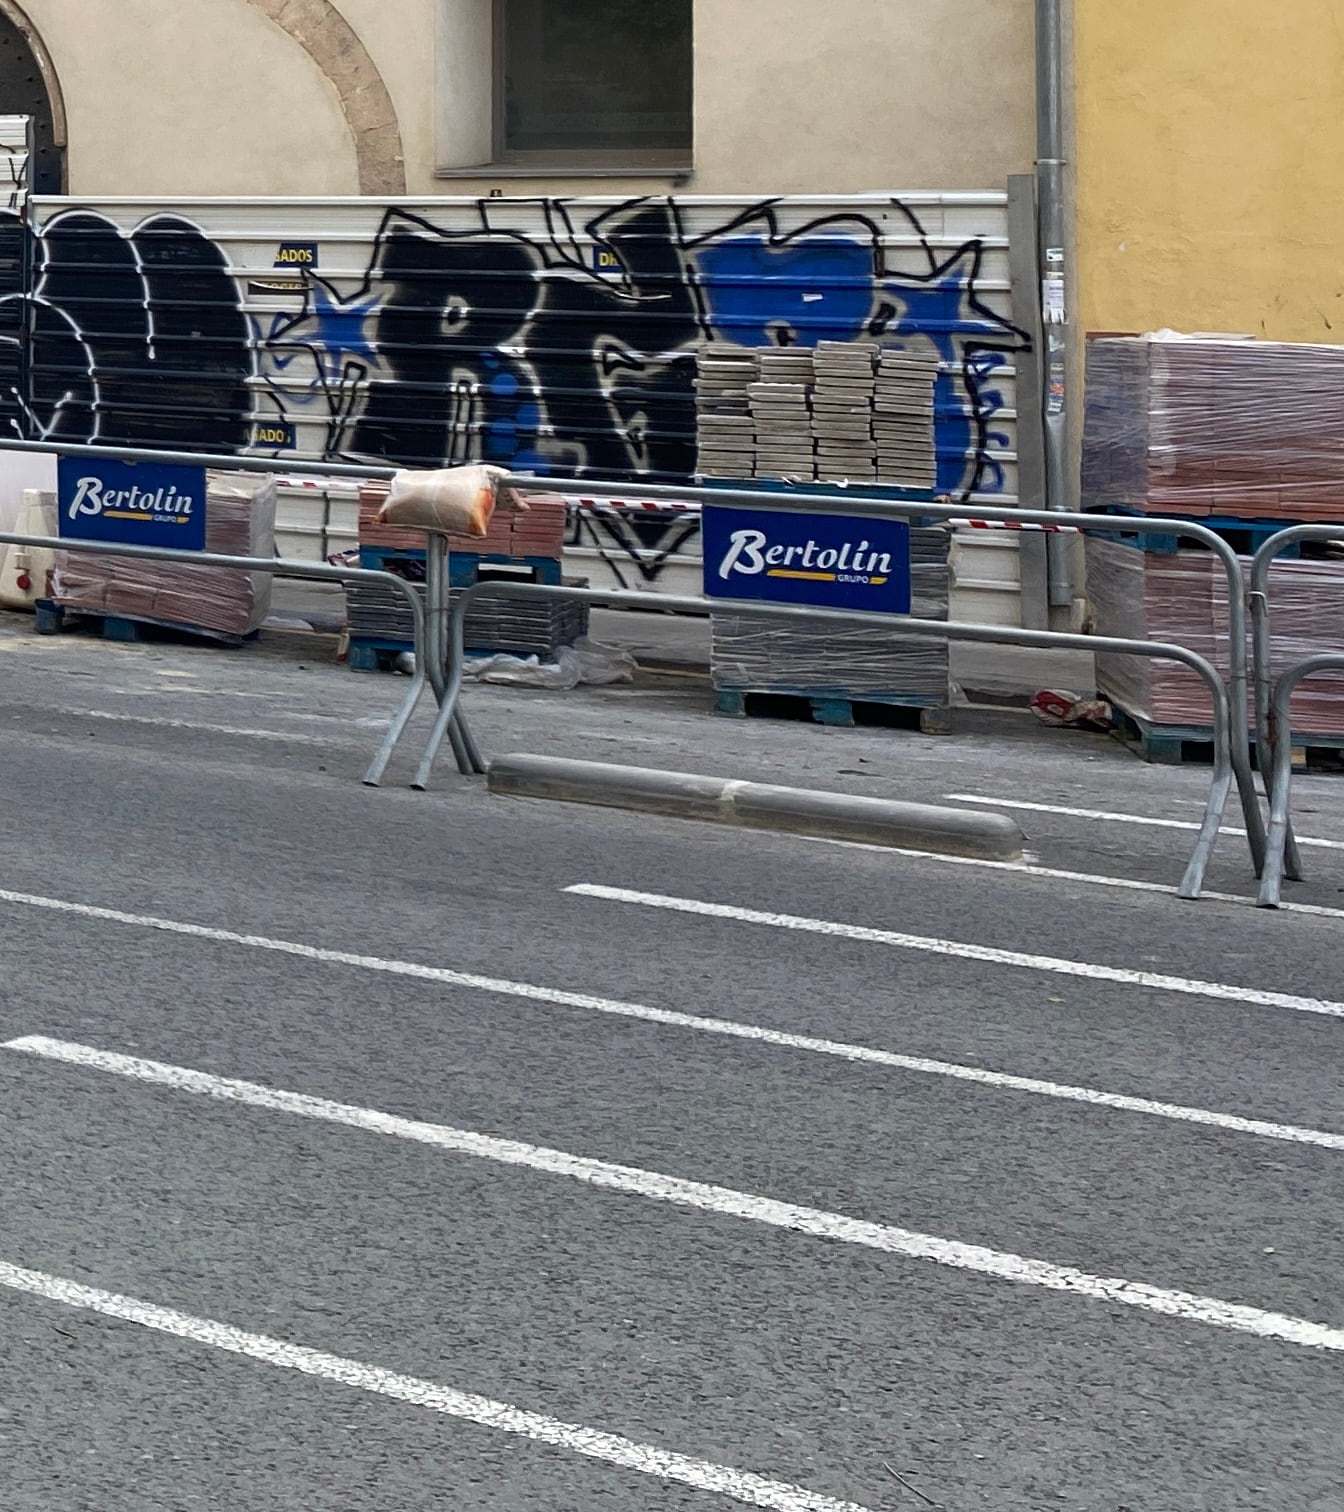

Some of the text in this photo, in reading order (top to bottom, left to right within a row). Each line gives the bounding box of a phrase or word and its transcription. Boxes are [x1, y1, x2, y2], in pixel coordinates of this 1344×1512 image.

[68, 476, 194, 521] Bertolín
[718, 528, 893, 581] Bertolín
[837, 573, 869, 585] GRUPO
